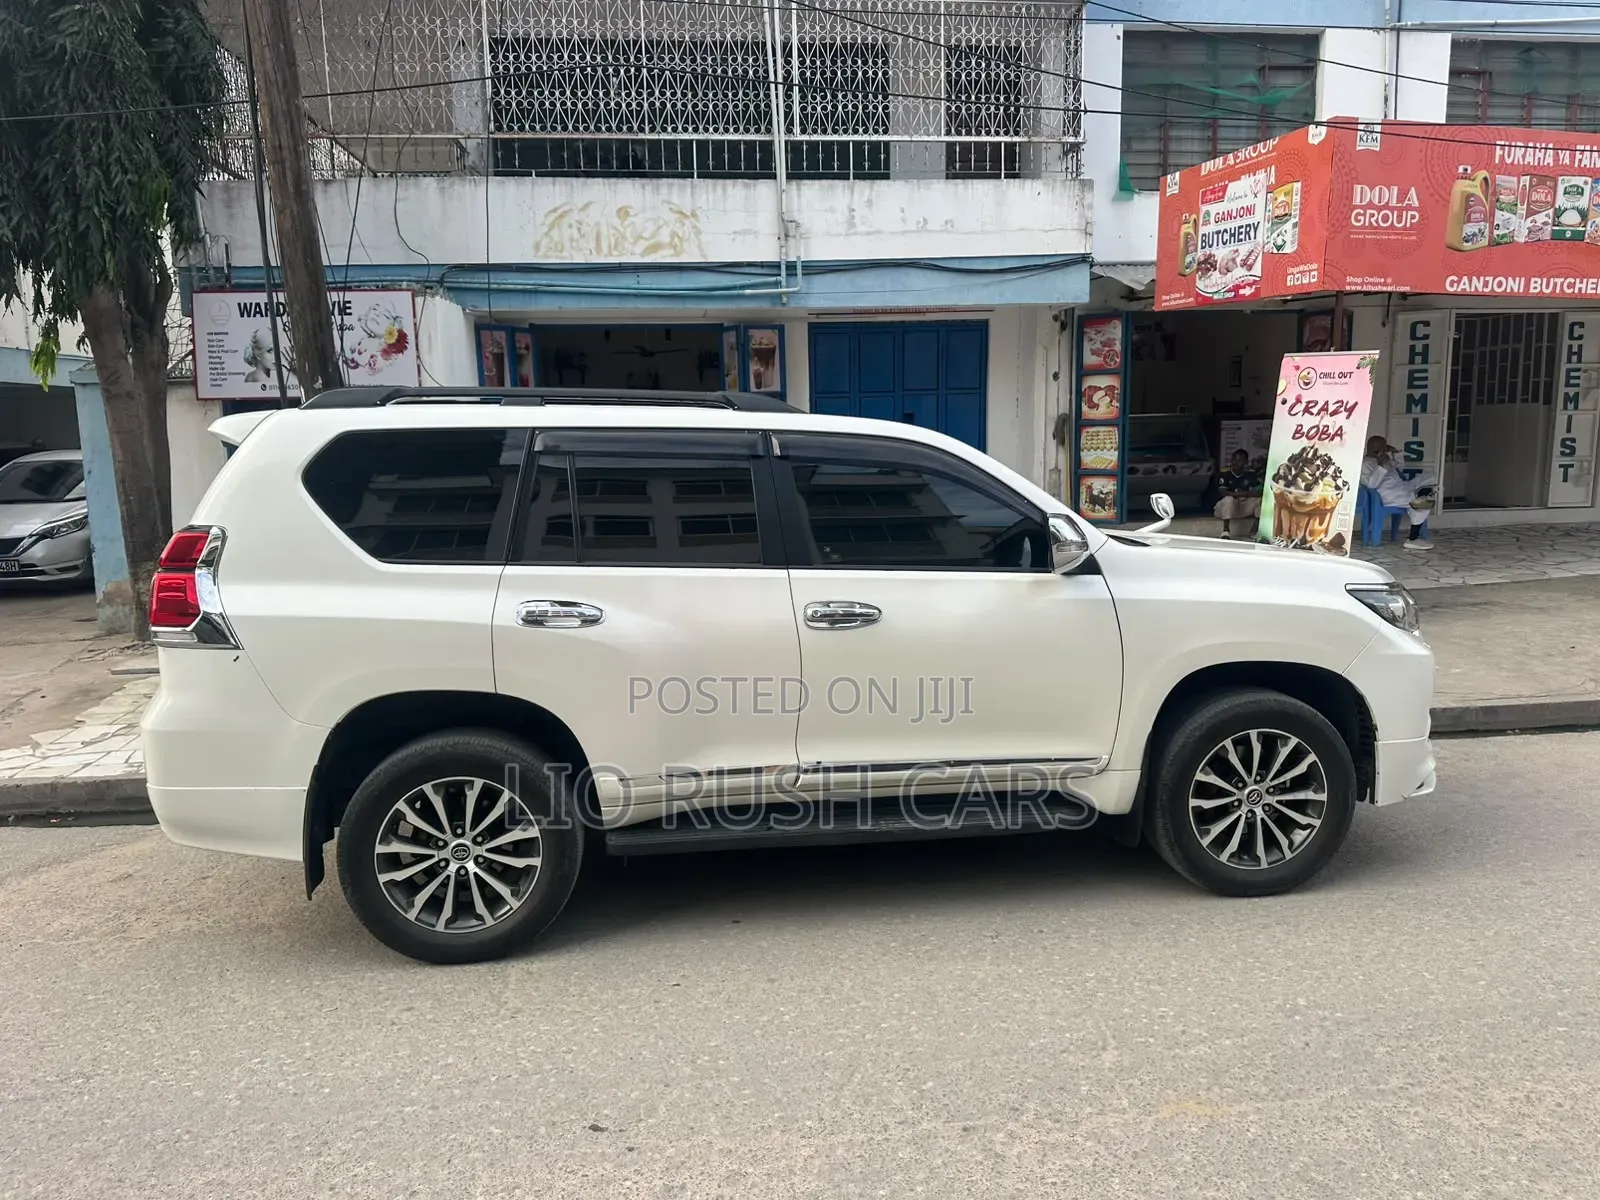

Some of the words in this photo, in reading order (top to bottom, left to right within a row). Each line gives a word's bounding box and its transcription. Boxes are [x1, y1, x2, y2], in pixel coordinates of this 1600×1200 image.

[1359, 134, 1378, 143] KFM
[1495, 141, 1553, 167] FURAHA
[1558, 149, 1569, 165] YA
[1352, 184, 1420, 207] DOLA
[1531, 191, 1552, 202] DOLA
[1214, 203, 1256, 224] GANJONI
[1350, 208, 1420, 228] GROUP
[1200, 221, 1260, 249] BUTCHERY
[1346, 276, 1363, 284] Shop
[1445, 275, 1524, 293] GANJONI
[1529, 277, 1600, 294] BUTCHE
[1319, 371, 1336, 379] CHILL
[1337, 371, 1354, 379] OUT
[1287, 399, 1359, 420] CRAZY
[1404, 320, 1431, 481] CHEMIST
[1558, 321, 1585, 483] CHEMIST
[1291, 423, 1344, 442] BOBA
